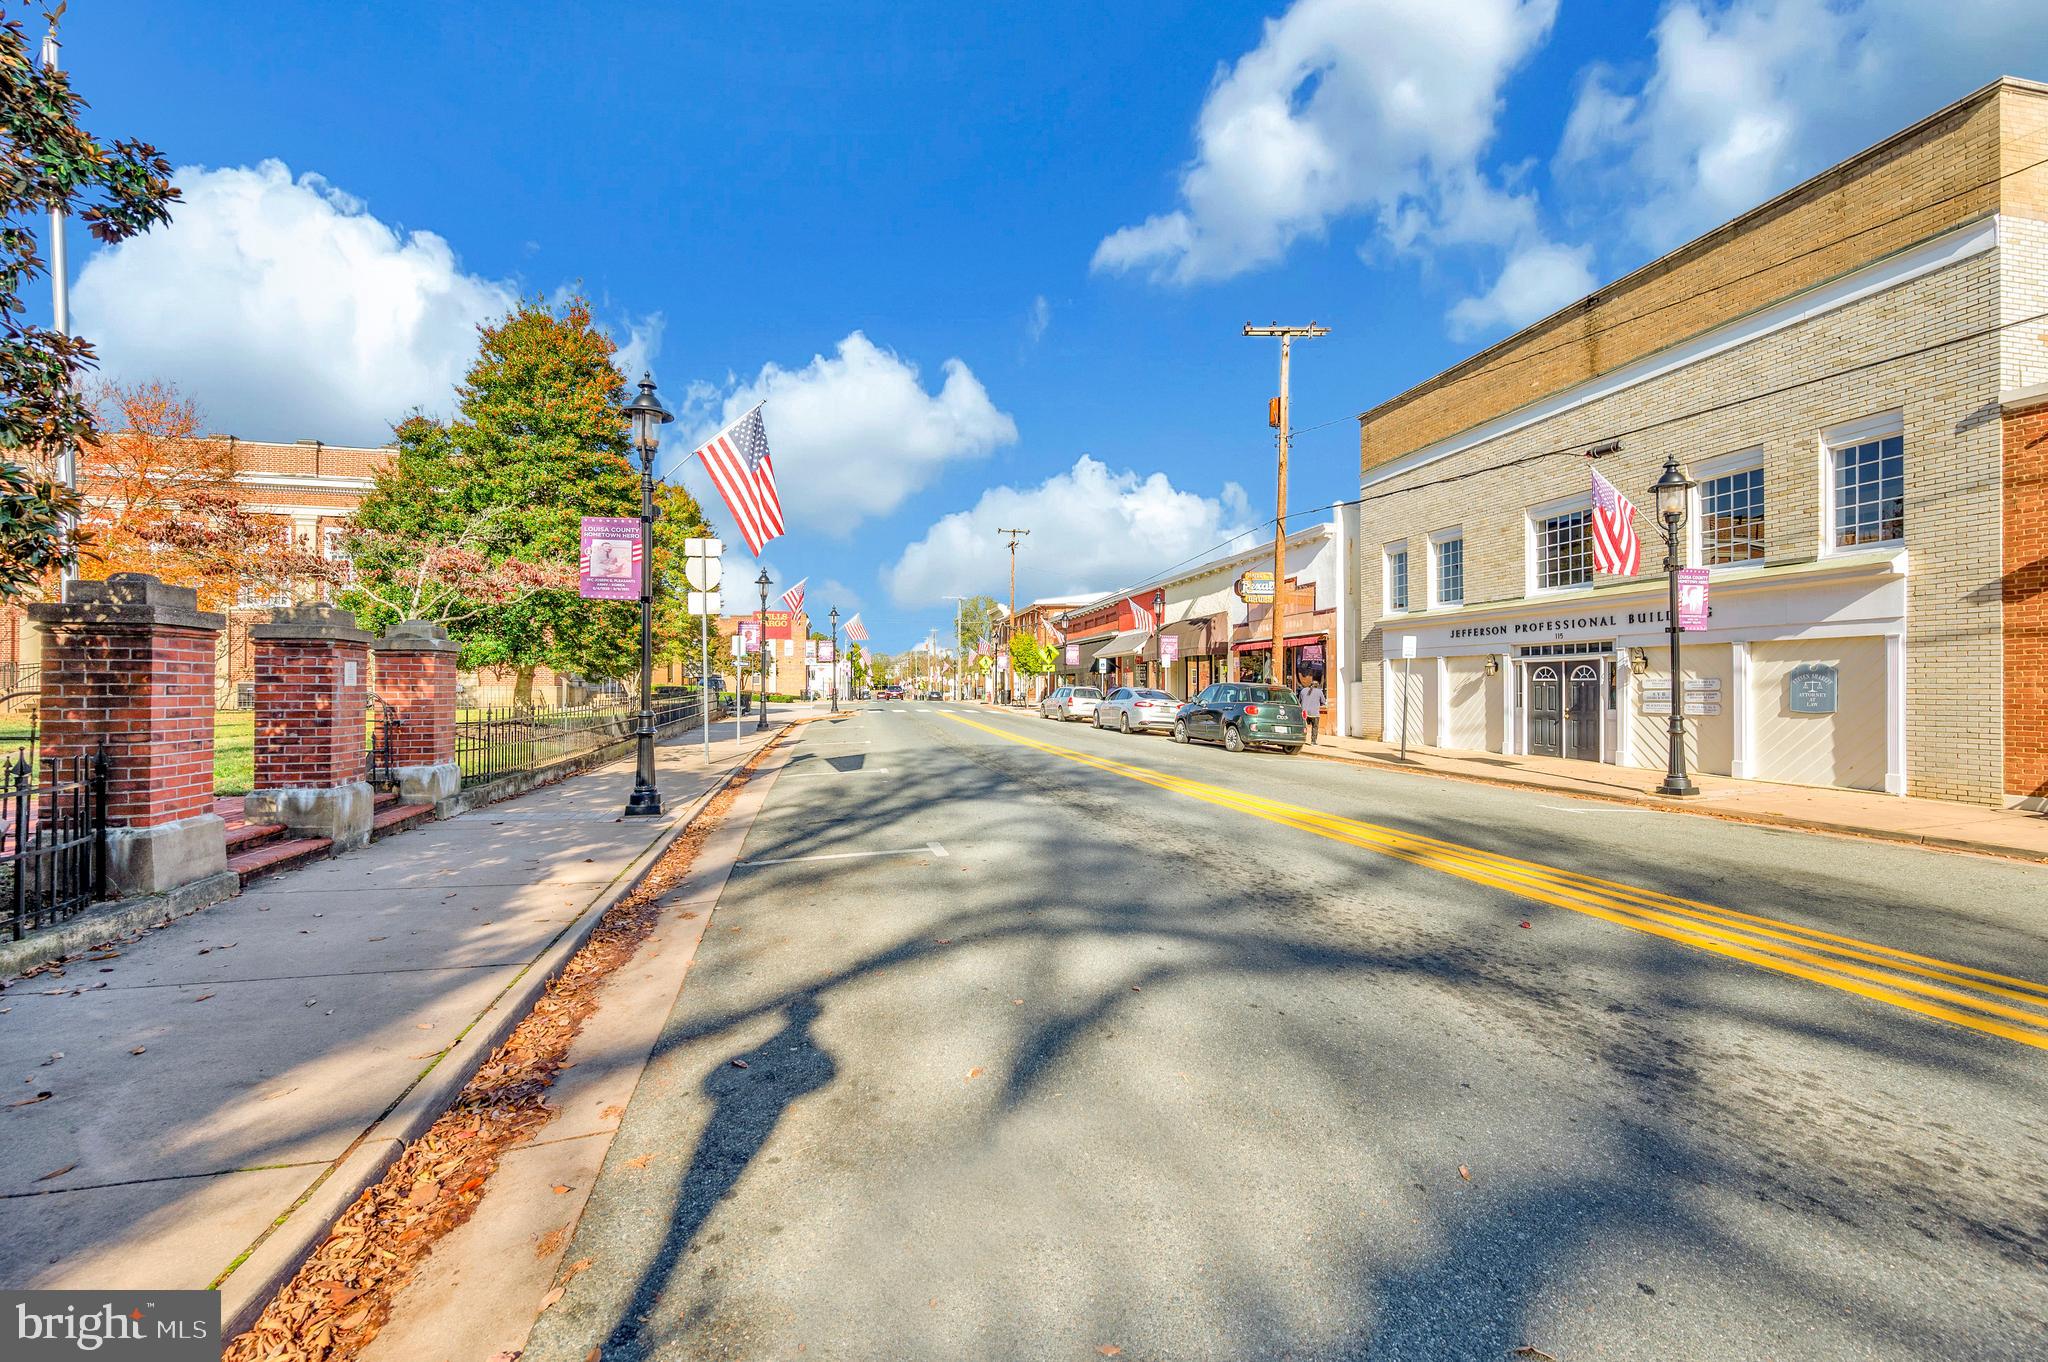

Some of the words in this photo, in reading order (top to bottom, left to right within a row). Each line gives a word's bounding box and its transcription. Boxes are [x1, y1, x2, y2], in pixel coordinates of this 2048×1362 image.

[1450, 625, 1507, 639] JEFFERSON
[1515, 616, 1616, 633] PROFESSIONAL
[1555, 632, 1564, 640] 115
